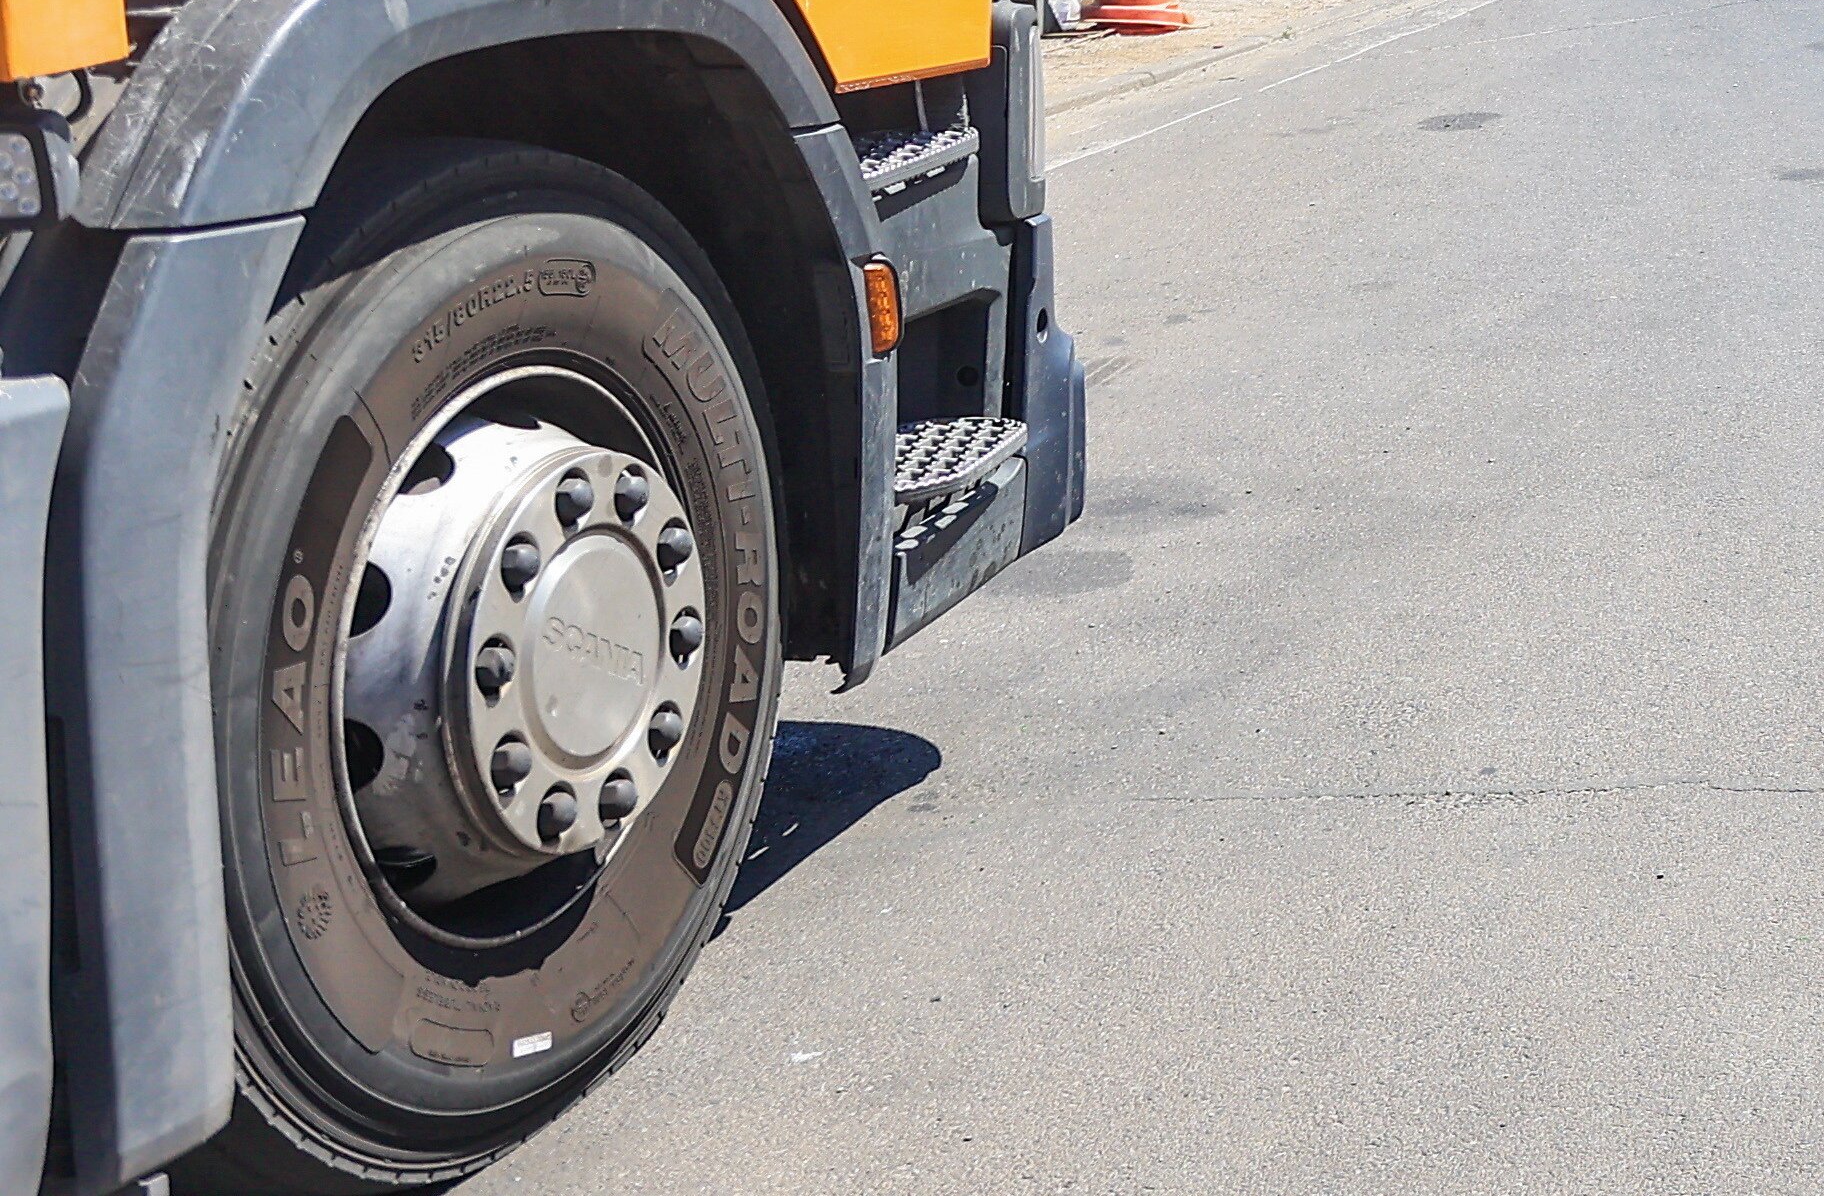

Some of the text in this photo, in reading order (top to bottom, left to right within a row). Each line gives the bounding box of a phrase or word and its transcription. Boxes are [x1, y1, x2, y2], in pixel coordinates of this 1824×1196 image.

[543, 616, 643, 685] SCANIA
[651, 304, 766, 776] MULTI-ROAD
[270, 573, 318, 867] LEAO
